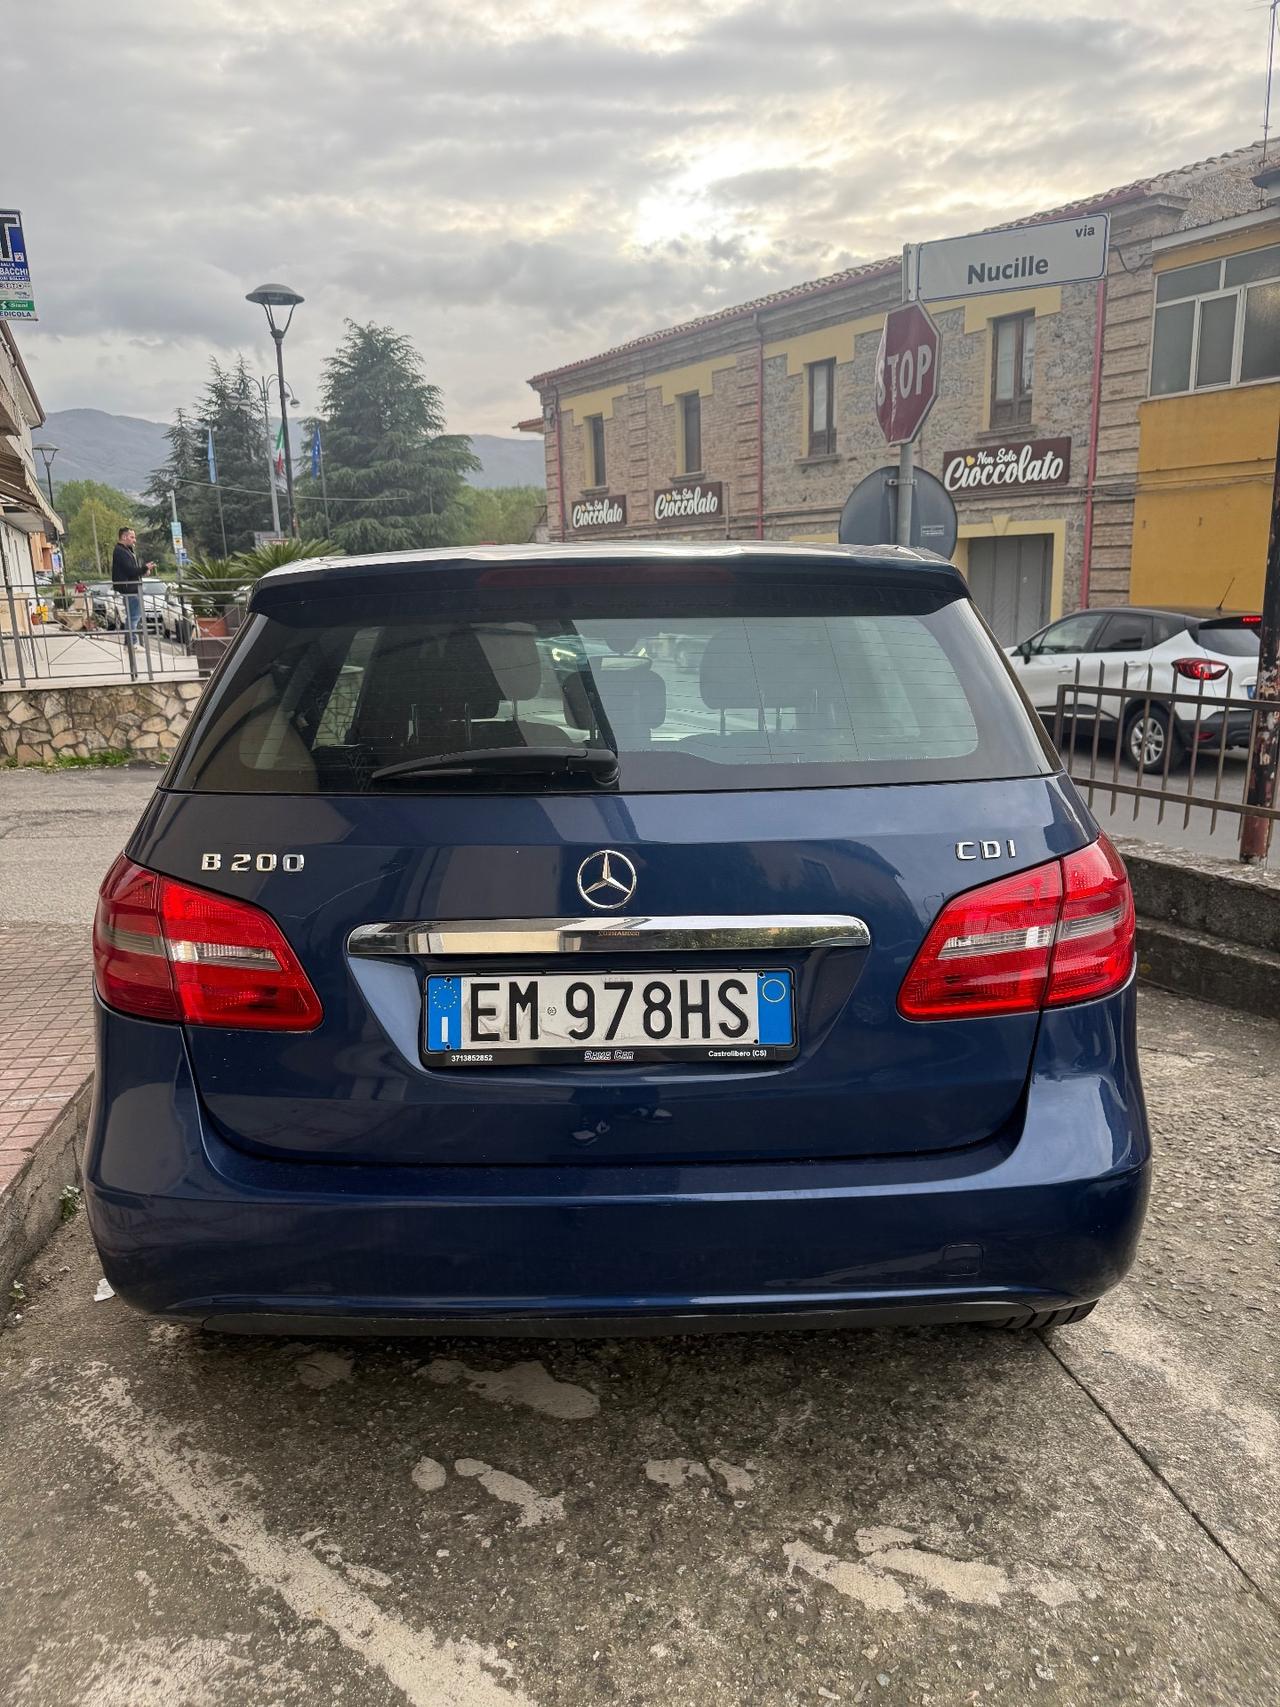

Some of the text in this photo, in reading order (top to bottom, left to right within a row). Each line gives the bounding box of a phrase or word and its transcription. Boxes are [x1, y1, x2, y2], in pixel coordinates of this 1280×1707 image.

[1075, 223, 1096, 239] via
[967, 255, 1050, 285] Nucille
[876, 344, 933, 406] STOP
[944, 444, 1065, 493] Cioccolato
[977, 447, 1017, 465] Non Solo
[572, 498, 623, 529] Cioccolato
[655, 486, 718, 520] Cioccolato
[201, 853, 305, 873] B 200
[955, 839, 1017, 861] CDI
[470, 978, 749, 1042] EM 978HS
[752, 1049, 767, 1057] (CS)
